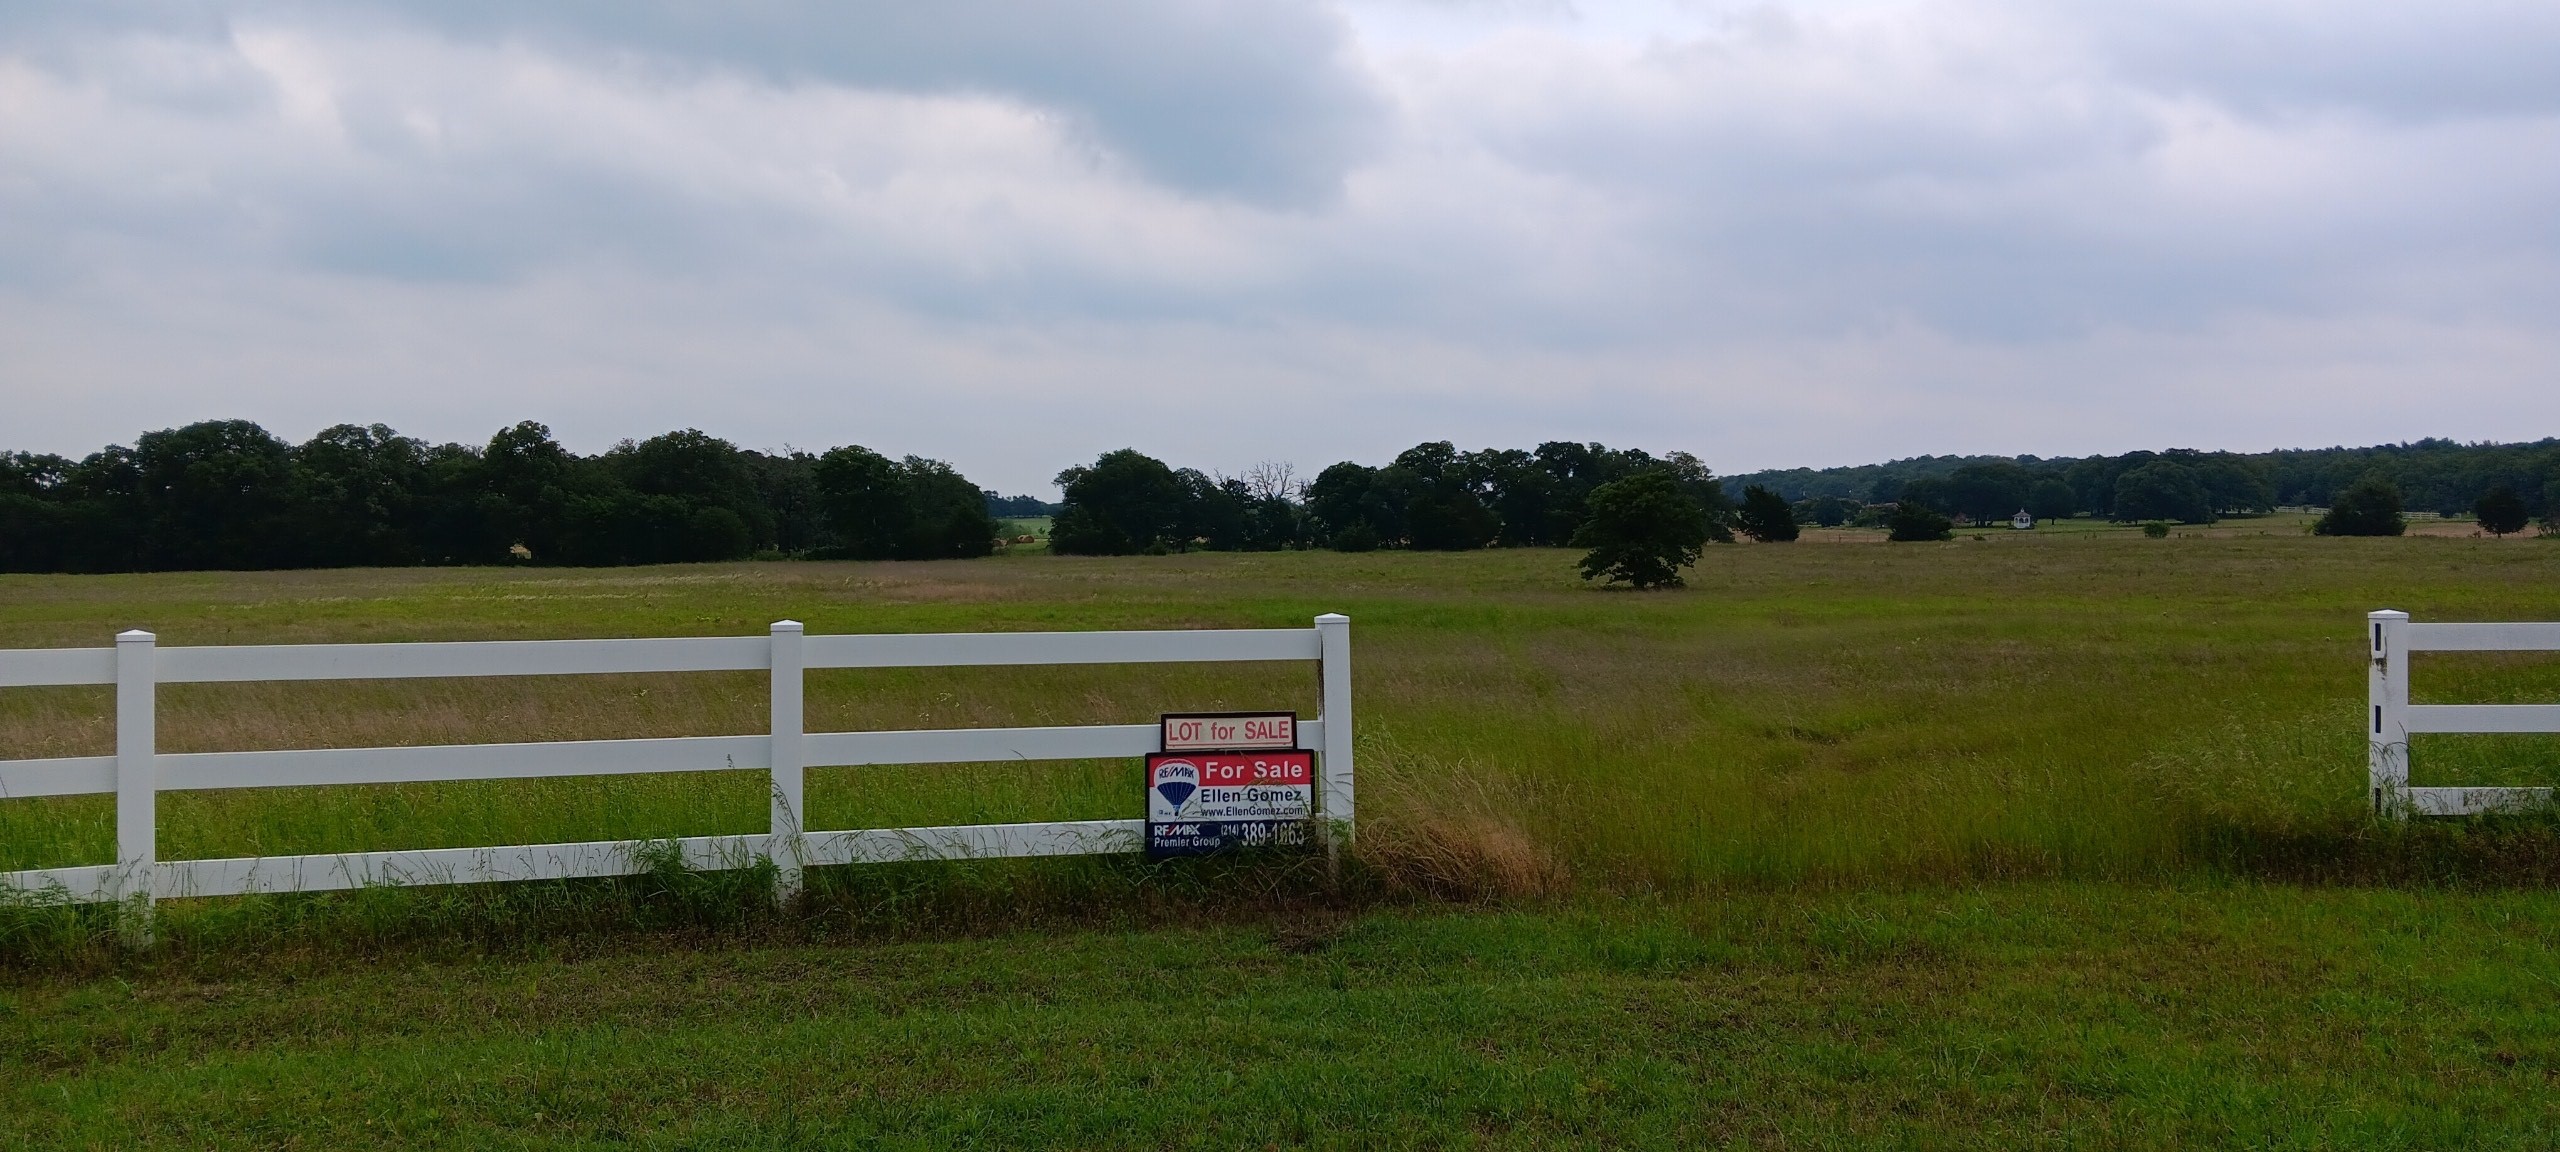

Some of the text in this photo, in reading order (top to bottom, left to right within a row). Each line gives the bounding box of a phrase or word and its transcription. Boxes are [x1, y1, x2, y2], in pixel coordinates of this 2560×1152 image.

[1168, 720, 1290, 741] LOT for SALE
[1158, 765, 1195, 779] RE/MAX
[1205, 760, 1303, 779] For Sale
[1200, 787, 1302, 803] Ellen Gomez
[1200, 805, 1303, 817] www.EllenGomez.com
[1154, 835, 1221, 848] Premier Group
